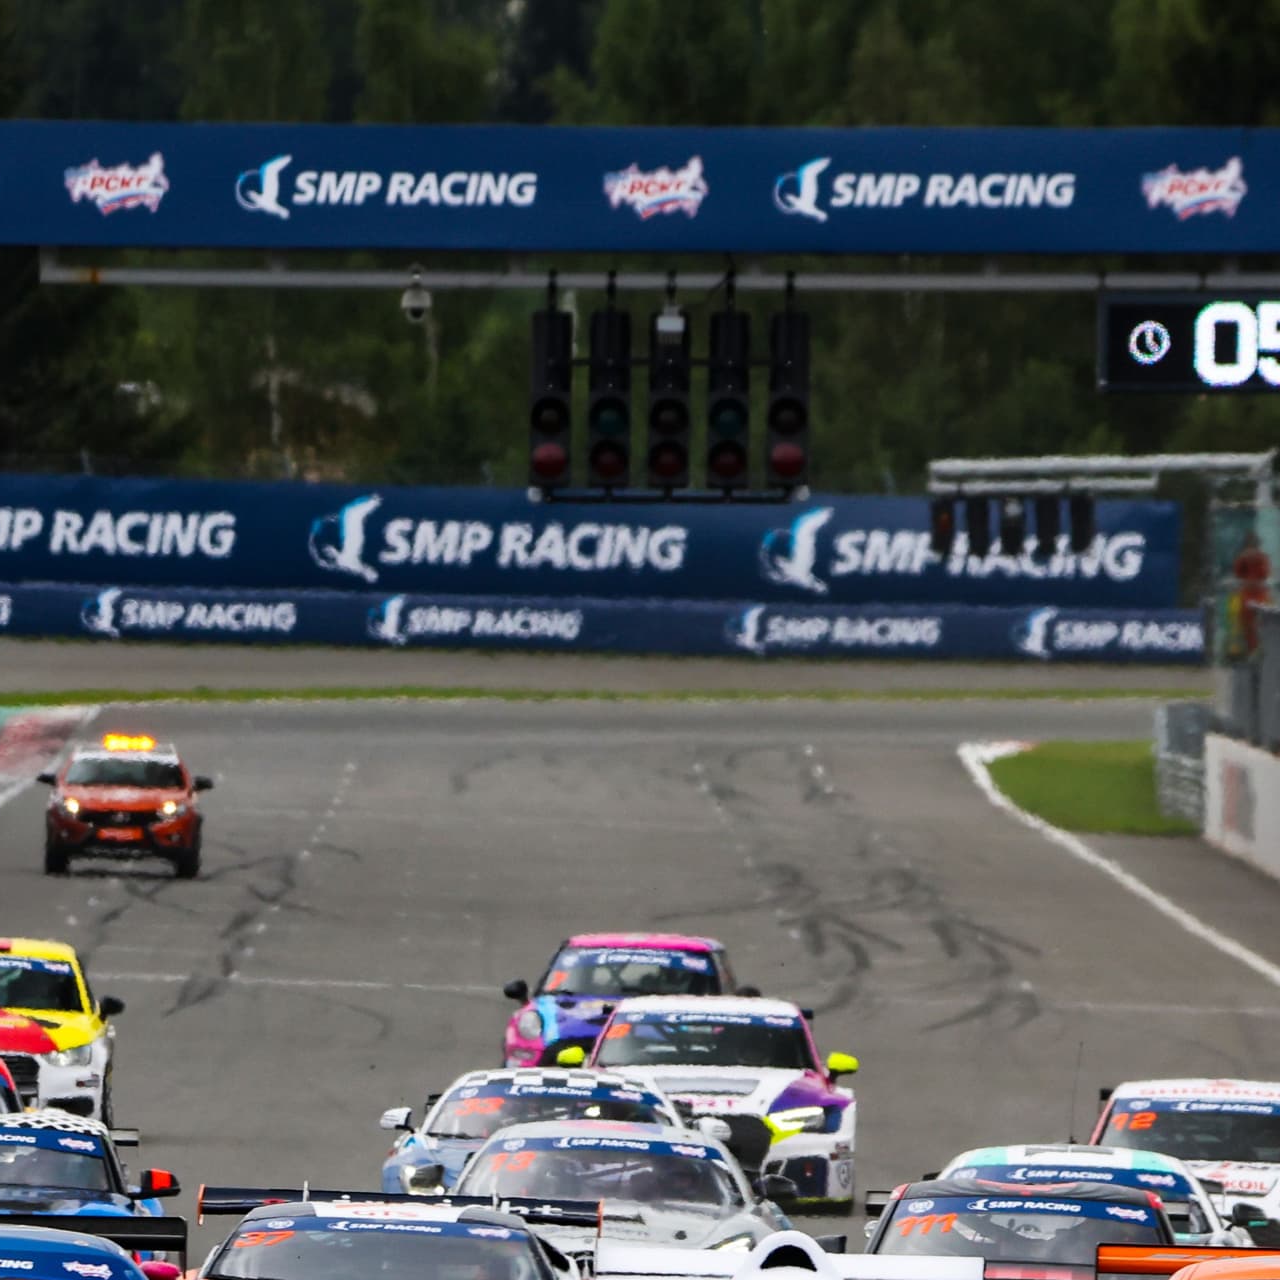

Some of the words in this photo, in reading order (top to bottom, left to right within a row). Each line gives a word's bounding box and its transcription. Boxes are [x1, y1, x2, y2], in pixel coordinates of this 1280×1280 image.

[292, 171, 382, 205] SMP
[386, 172, 538, 207] RACING
[830, 173, 921, 207] SMP
[924, 173, 1076, 208] RACING
[49, 510, 237, 558] RACING
[380, 518, 494, 565] SMP
[497, 523, 688, 572] RACING
[120, 600, 184, 628] SMP
[187, 602, 297, 632] RACING
[406, 606, 470, 634] SMP
[472, 609, 581, 640] RACING
[765, 615, 828, 644] SMP
[830, 616, 942, 648] RACING
[1054, 620, 1118, 650] SMP
[1110, 1111, 1158, 1131] 12
[490, 1151, 537, 1172] 13
[1026, 1169, 1060, 1179] SMP
[1060, 1170, 1115, 1181] RACING
[988, 1200, 1023, 1210] SMP
[1024, 1201, 1082, 1213] RACING
[234, 1230, 296, 1248] 37
[349, 1222, 383, 1231] SMP
[383, 1223, 442, 1234] RACING
[896, 1212, 959, 1237] 111
